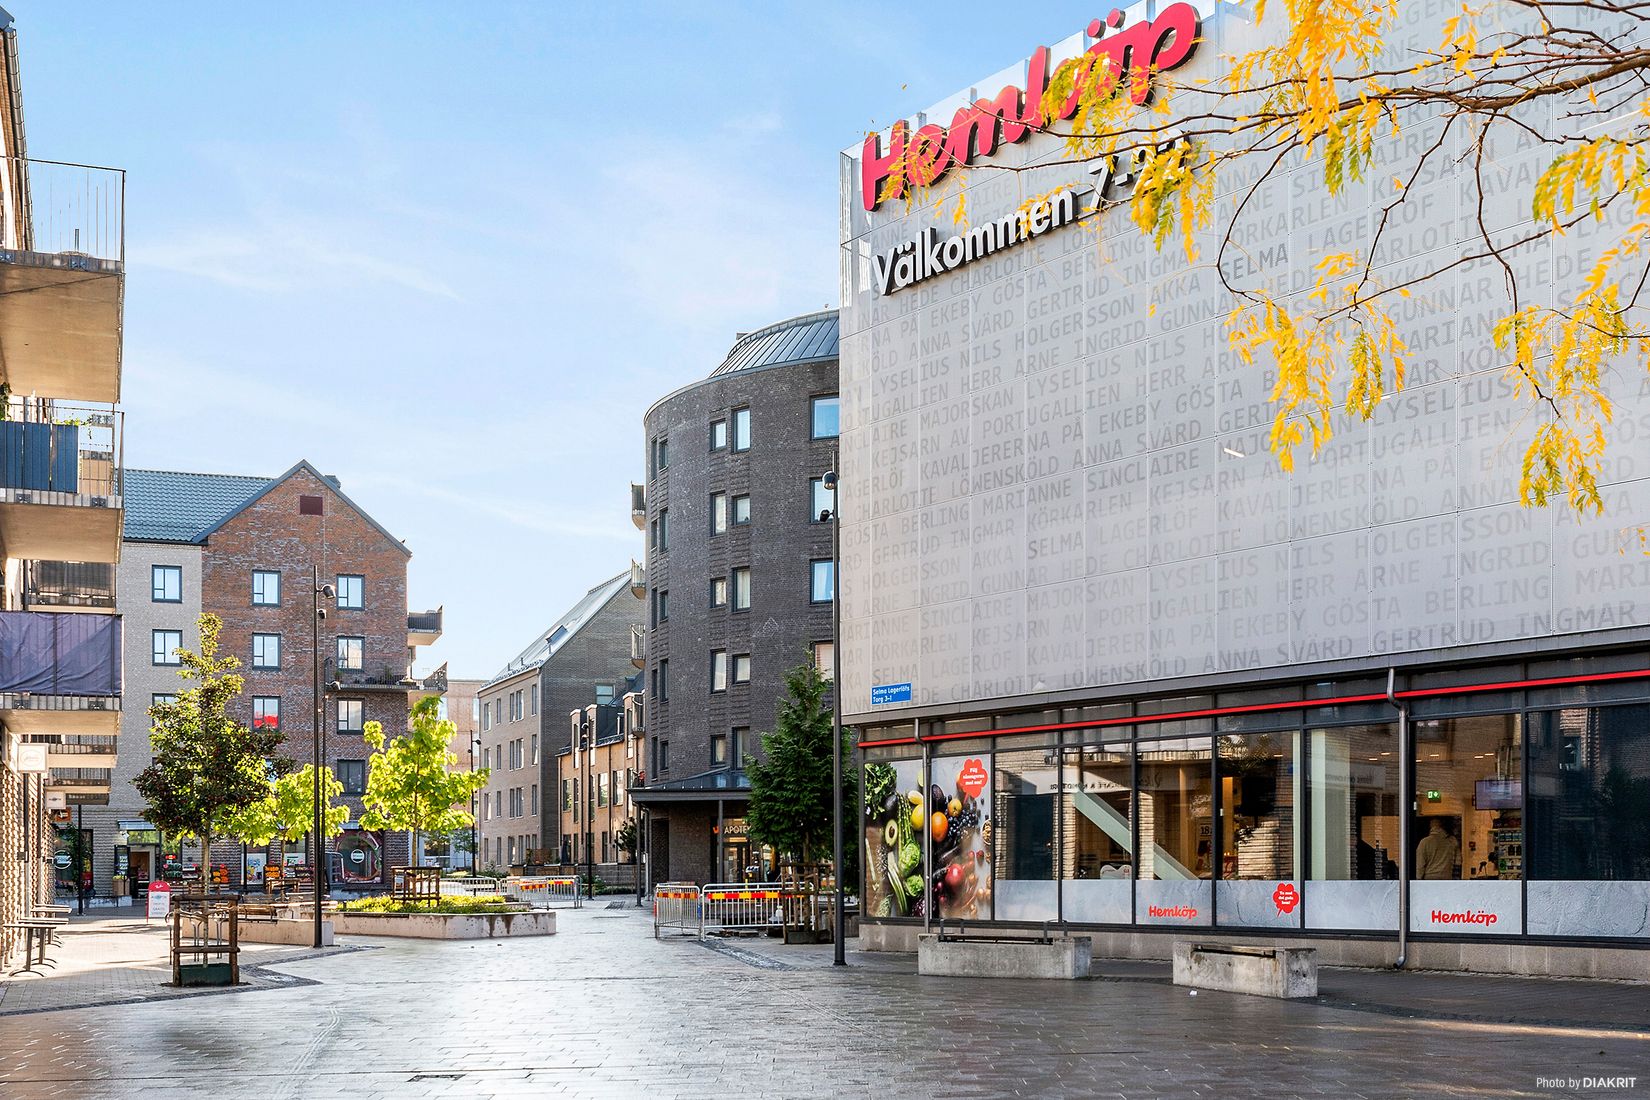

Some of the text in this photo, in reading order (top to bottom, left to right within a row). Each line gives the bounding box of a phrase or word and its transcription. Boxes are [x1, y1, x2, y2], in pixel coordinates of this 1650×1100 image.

[872, 190, 1077, 295] Välkommen
[900, 283, 938, 315] HEDE
[950, 241, 1048, 296] CHARLOTTE
[900, 311, 918, 340] PÅ
[930, 293, 980, 329] EKEBY
[993, 263, 1048, 306] GÖSTA
[1061, 232, 1146, 282] BERLING
[872, 355, 949, 398] LYSELIUS
[961, 337, 1002, 369] NILS
[1015, 293, 1134, 351] HOLGERSSON
[1148, 270, 1201, 308] AKKA
[1217, 241, 1288, 286] SELMA
[910, 330, 949, 361] ANNA
[961, 302, 1013, 343] SVÄRD
[1026, 274, 1108, 321] GERTRUD
[1123, 241, 1201, 288] INGMAR
[961, 363, 1002, 394] HERR
[1015, 345, 1059, 378] ARNE
[1073, 317, 1146, 360] INGRID
[872, 434, 938, 470] KEJSARN
[950, 425, 970, 448] AV
[982, 381, 1121, 439] PORTUGALLIEN
[1136, 362, 1187, 397] HERR
[1514, 246, 1590, 292] HEDE
[920, 386, 1013, 432] MAJORSKAN
[1026, 353, 1121, 400] LYSELIUS
[1136, 333, 1187, 368] NILS
[845, 516, 889, 548] GÖSTA
[900, 501, 970, 535] BERLING
[982, 477, 1071, 516] MARIANNE
[1085, 446, 1201, 493] SINCLAIRE
[1371, 372, 1511, 428] LYSELIUS
[854, 484, 938, 522] CHARLOTTE
[950, 448, 1059, 498] LÖWENSKÖLD
[1073, 437, 1121, 468] ANNA
[1136, 411, 1201, 453] SVÄRD
[920, 429, 1048, 481] KAVALJERERNA
[1061, 414, 1083, 444] PÅ
[1098, 399, 1160, 435] EKEBY
[1175, 370, 1243, 415] GÖSTA
[862, 555, 959, 591] HOLGERSSON
[971, 544, 1013, 570] AKKA
[1026, 529, 1083, 559] SELMA
[1098, 499, 1201, 546] LAGERLÖF
[1217, 463, 1402, 522] KAVALJERERNA
[1422, 446, 1455, 482] PÅ
[862, 475, 1511, 615] ARNE INGRID GUNNAR HEDE CHARLOTTE LÖWENSKÖLD ANNA
[872, 534, 938, 566] GERTRUD
[950, 517, 1013, 549] INGMAR
[1026, 485, 1134, 533] KÖRKARLEN
[1148, 466, 1243, 507] KEJSARN
[920, 596, 1013, 630] SINCLAIRE
[1026, 575, 1134, 612] MAJORSKAN
[1148, 554, 1258, 592] LYSELIUS
[1276, 540, 1336, 572] NILS
[1354, 506, 1530, 559] HOLGERSSON
[872, 626, 959, 661] KÖRKARLEN
[971, 617, 1047, 647] KEJSARN
[1061, 611, 1083, 634] AV
[1098, 584, 1258, 628] PORTUGALLIEN
[1276, 572, 1336, 602] HERR
[1354, 558, 1420, 591] ARNE
[1440, 538, 1550, 578] INGRID
[872, 662, 918, 685] SELMA
[930, 643, 1013, 678] LAGERLÖF
[1026, 626, 1173, 665] KAVALJERERNA
[1189, 614, 1215, 644] PÅ
[1231, 608, 1304, 639] EKEBY
[1322, 587, 1402, 627] GÖSTA
[1422, 573, 1550, 614] BERLING
[1061, 647, 1187, 688] LÖWENSKÖLD
[1203, 644, 1258, 672] ANNA
[1276, 626, 1352, 664] SVÄRD
[1371, 615, 1492, 653] GERTRUD
[1514, 598, 1633, 636] INGMAR
[1149, 905, 1197, 920] Hemköp
[1431, 910, 1497, 926] Hemköp
